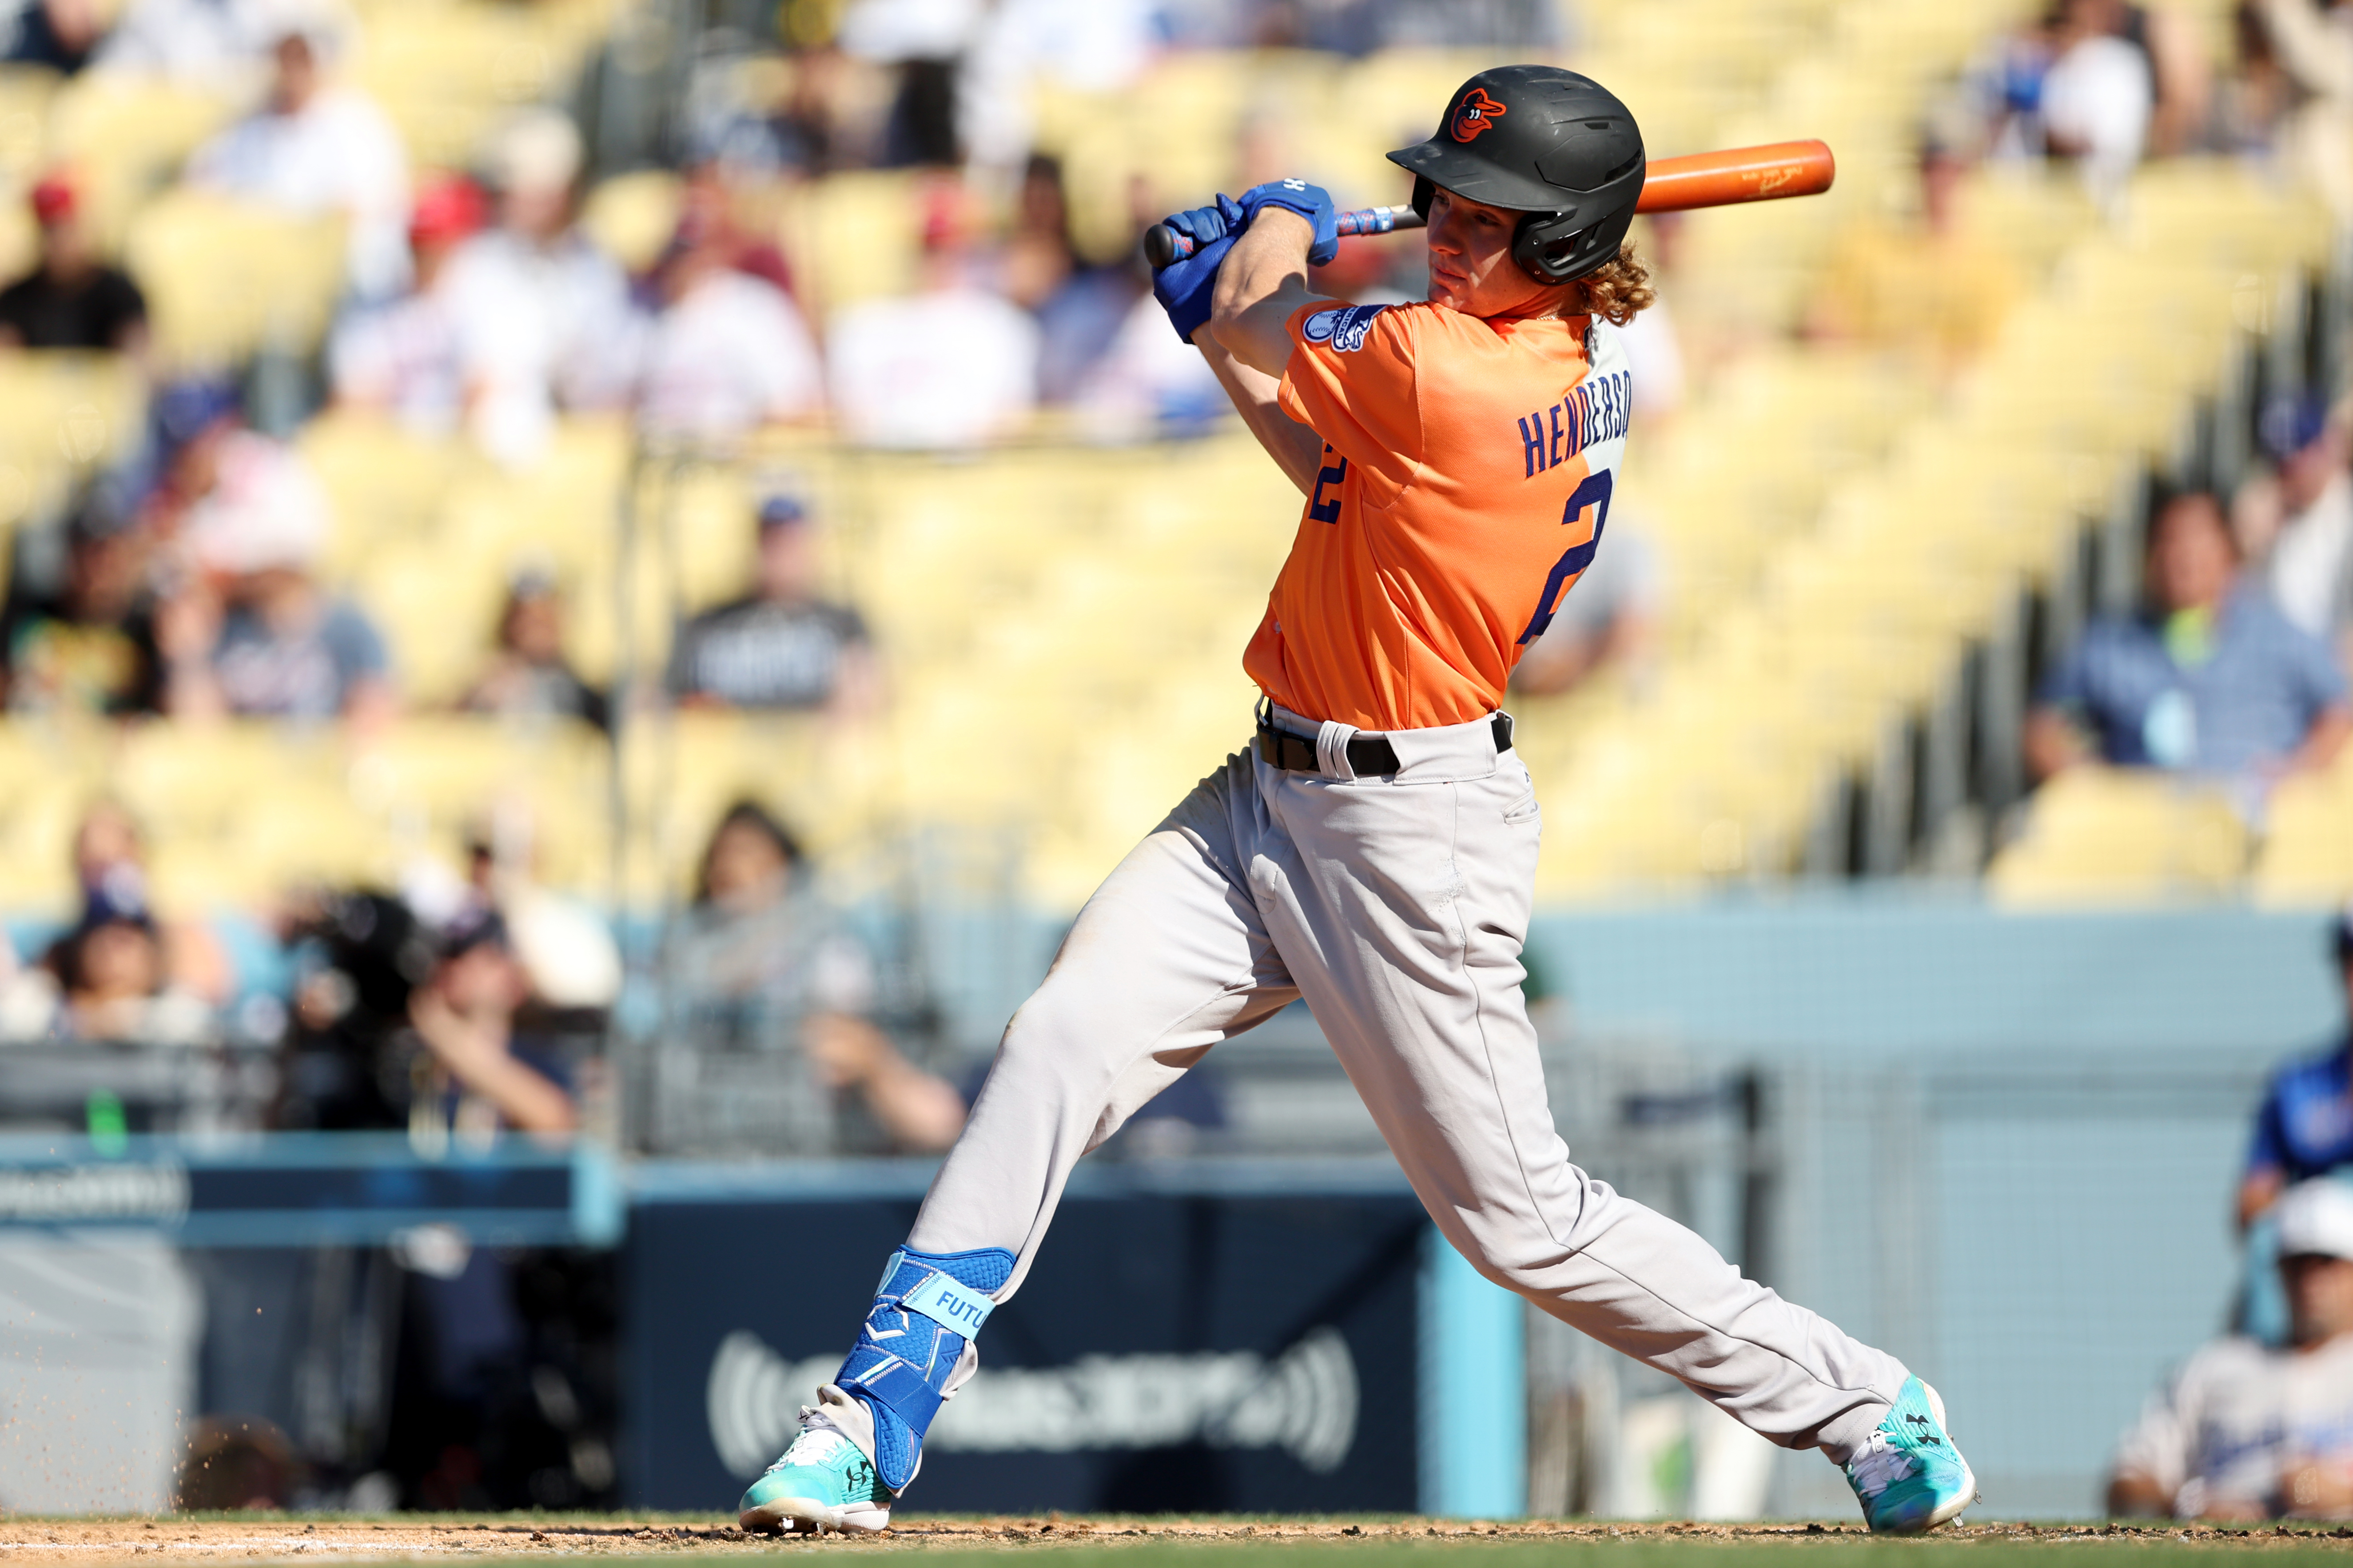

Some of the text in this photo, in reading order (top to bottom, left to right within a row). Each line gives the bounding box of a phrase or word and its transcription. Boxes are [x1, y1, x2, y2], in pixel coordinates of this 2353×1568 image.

[1337, 306, 1357, 339] ERICAN
[1518, 370, 1631, 478] HENDERSO
[1309, 443, 1348, 524] 2
[1516, 468, 1612, 644] 2
[936, 1290, 987, 1329] FUTU
